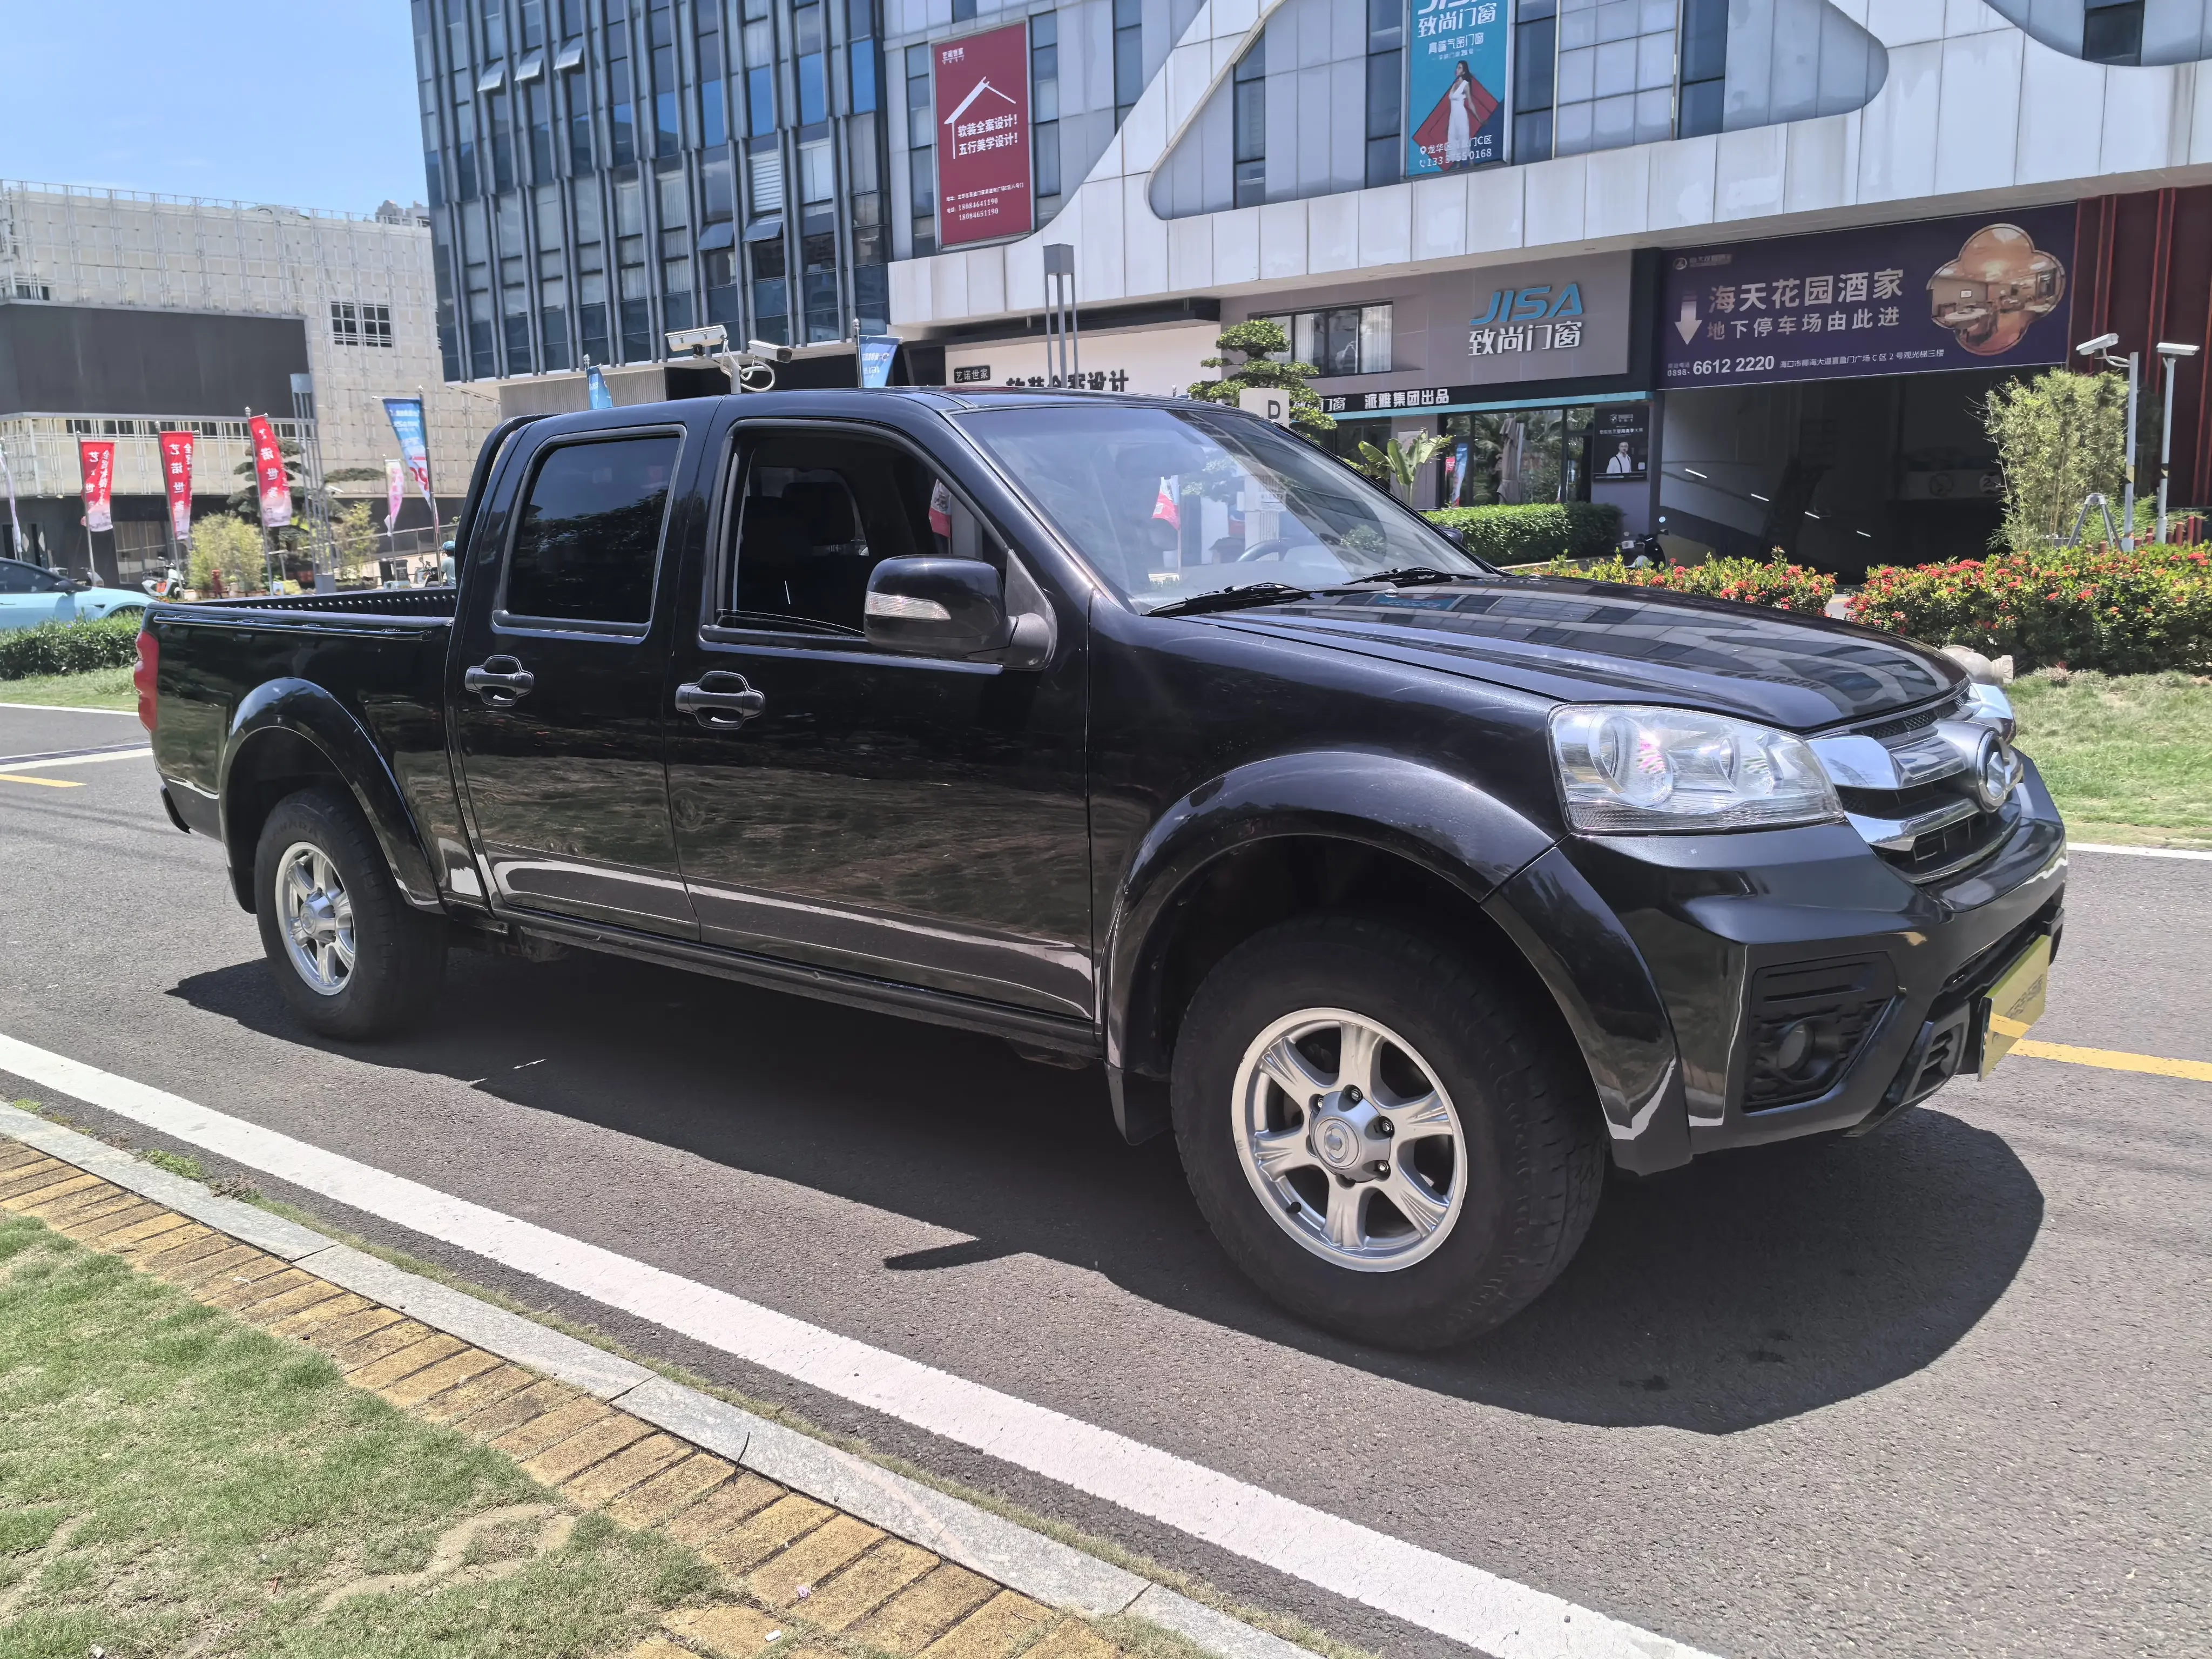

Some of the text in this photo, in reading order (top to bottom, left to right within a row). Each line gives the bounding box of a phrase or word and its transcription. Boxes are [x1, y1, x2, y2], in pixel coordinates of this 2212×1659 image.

[1417, 3, 1497, 38] 致尚门窗
[1469, 283, 1582, 326] JISA
[1708, 268, 1903, 313] 海天花园酒家
[1468, 321, 1582, 356] 致尚门窗
[1707, 306, 1899, 340] 地下停车场由此进
[954, 368, 988, 381] 艺诺世家
[1693, 359, 1731, 375] 6612
[1735, 356, 1775, 372] 2220
[1365, 388, 1450, 410] 派雅集团出品
